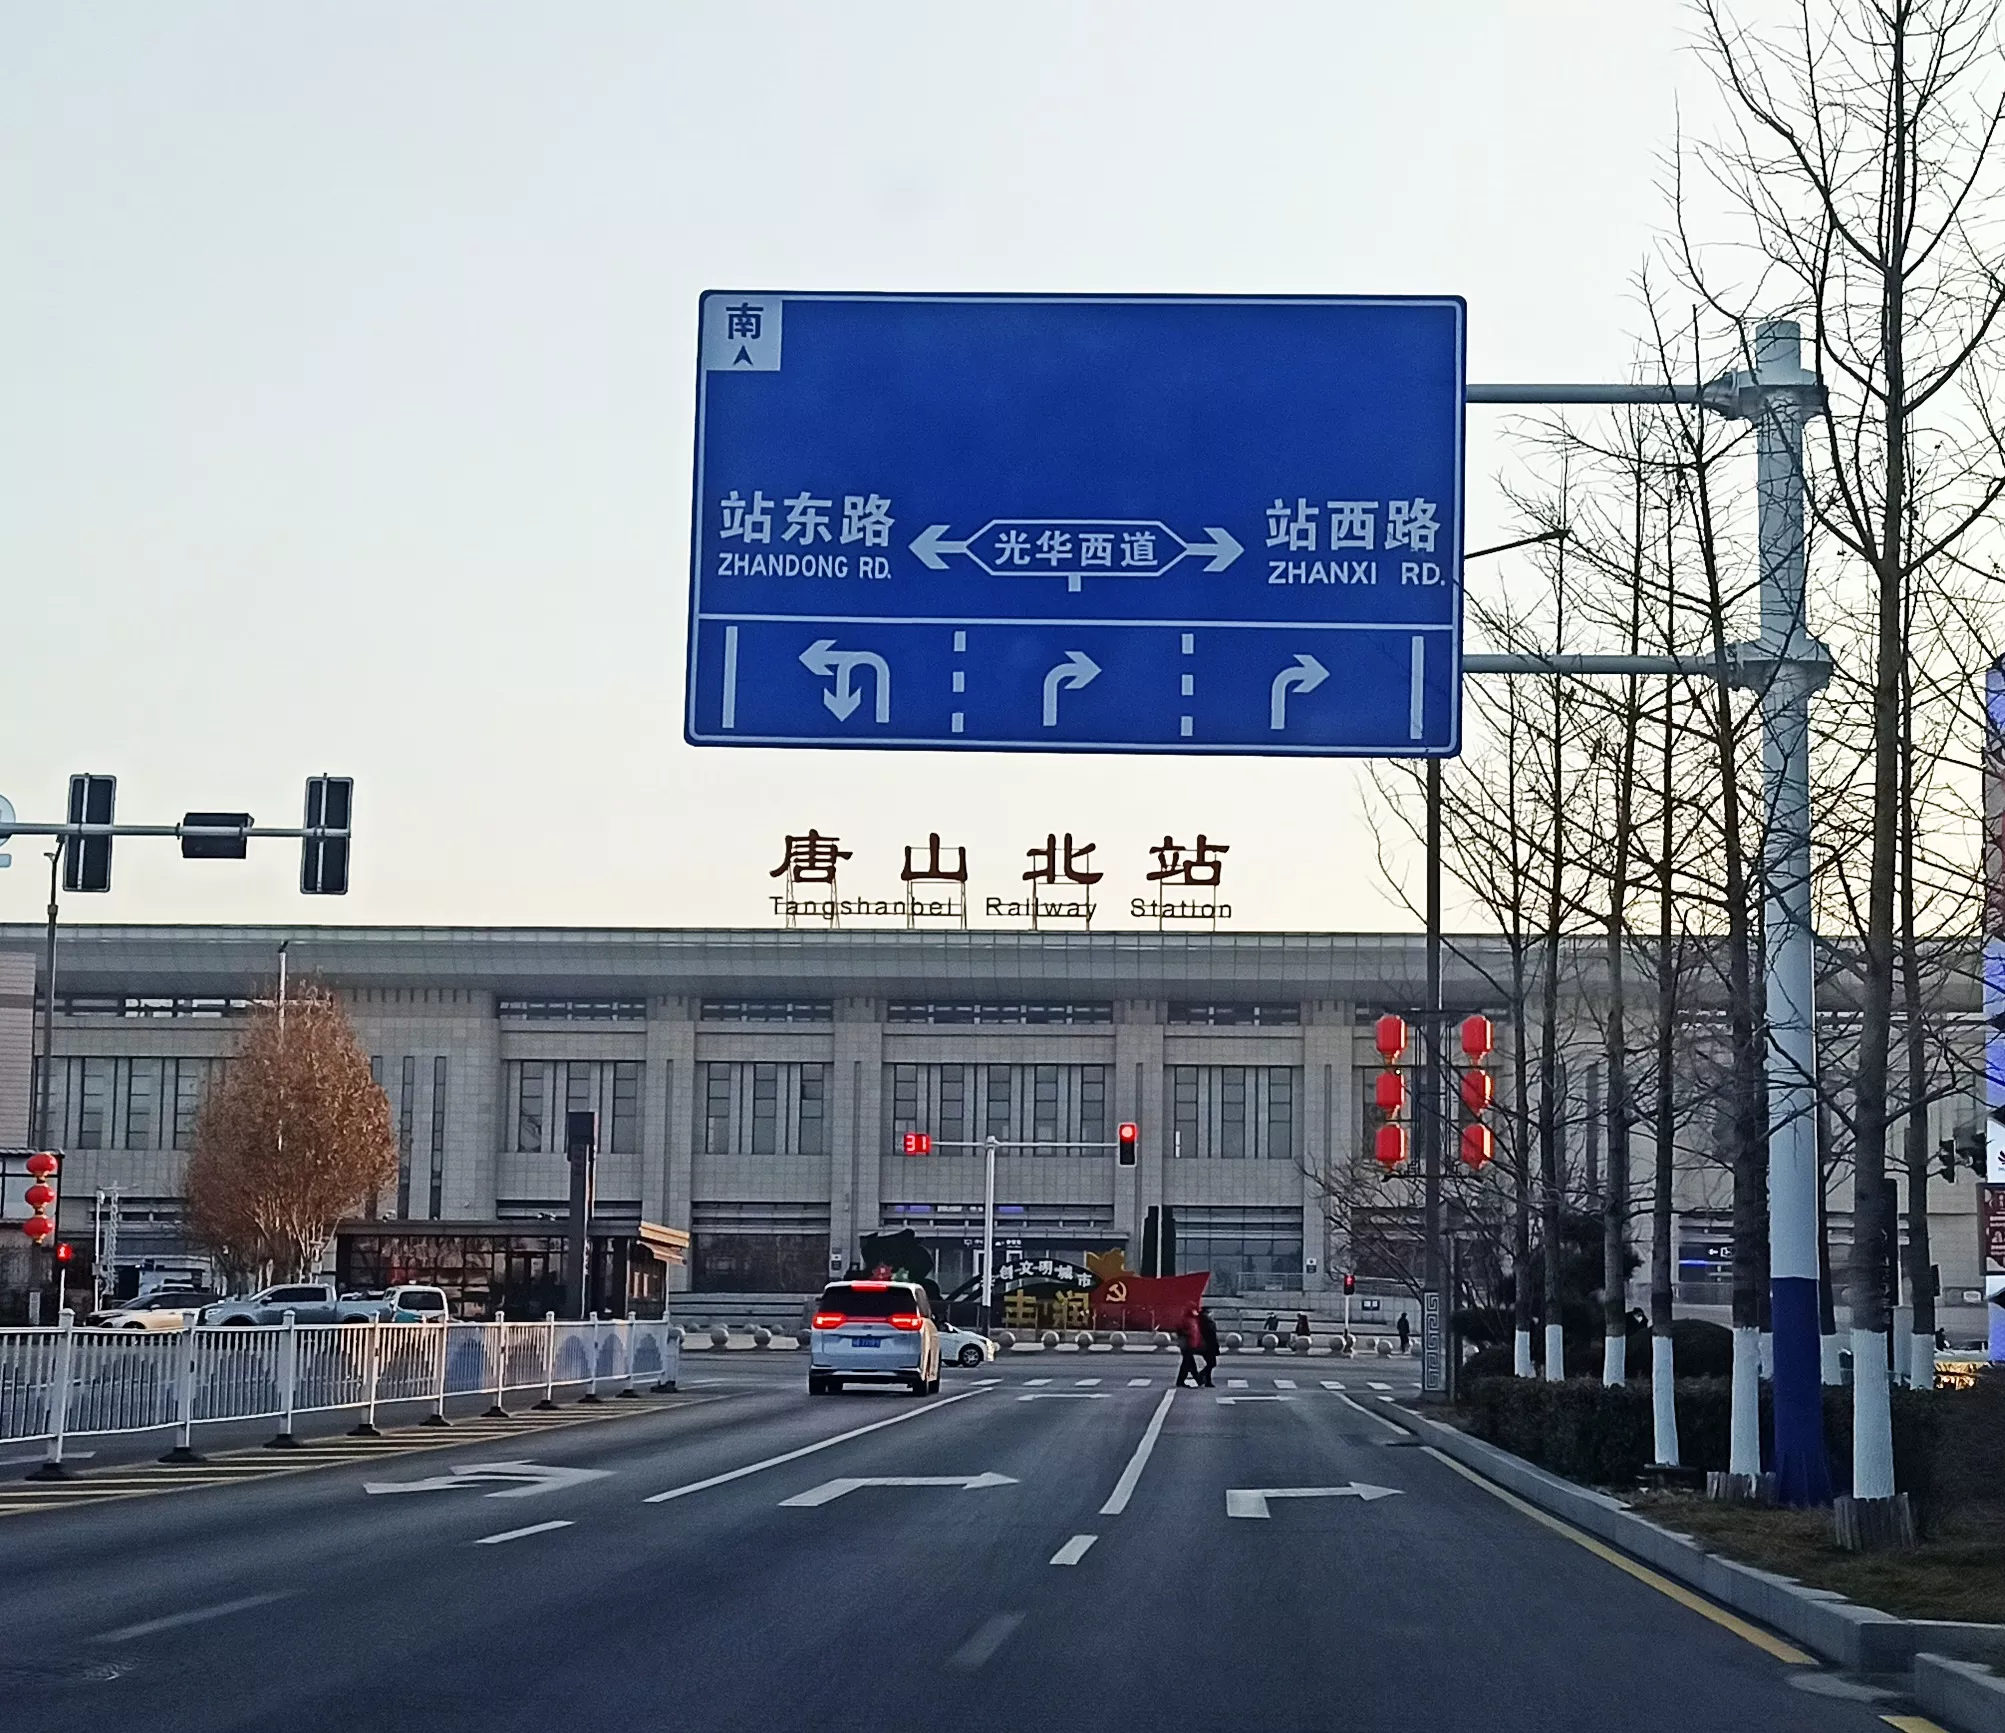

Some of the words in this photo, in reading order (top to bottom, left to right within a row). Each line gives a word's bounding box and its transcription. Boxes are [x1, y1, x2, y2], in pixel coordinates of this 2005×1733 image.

[725, 302, 764, 340] 南
[719, 490, 896, 547] 站东路
[1265, 497, 1441, 553] 站西路
[717, 552, 849, 579] ZHANDONG
[858, 556, 892, 580] RD.
[994, 529, 1159, 568] 光华西道
[1267, 560, 1377, 585] ZHANXI
[1401, 561, 1446, 587] RD.
[769, 828, 1230, 886] 唐山北站
[769, 896, 953, 920] Tangshanbei
[985, 896, 1098, 919] Railway
[1129, 896, 1233, 919] Station
[905, 1134, 928, 1152] 31
